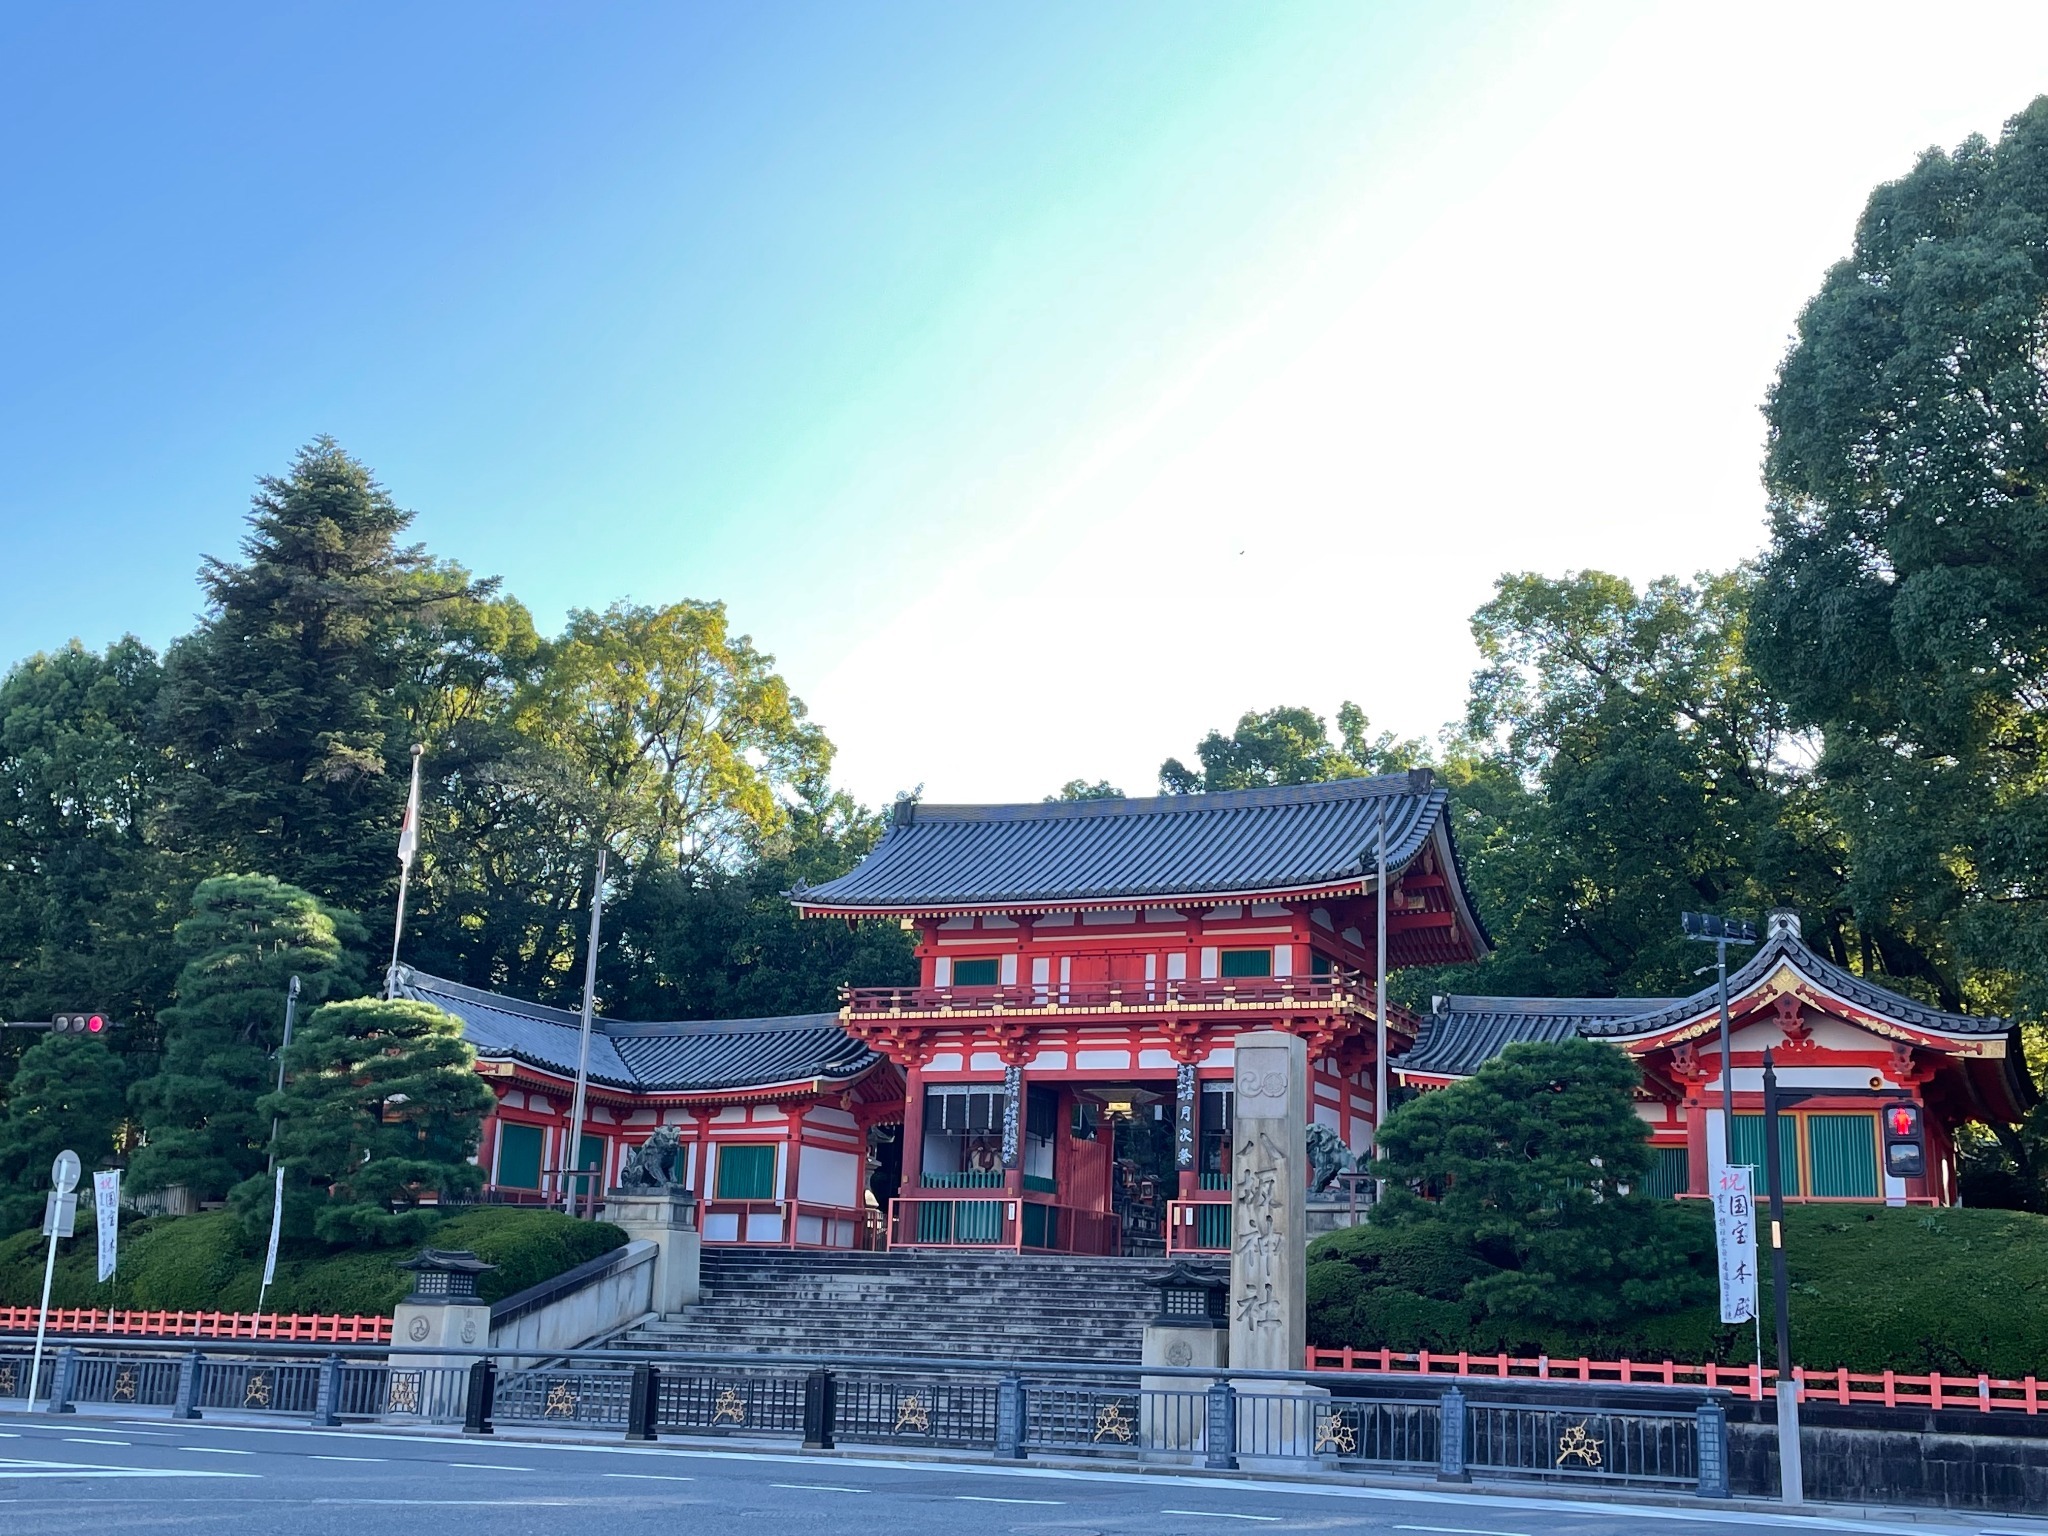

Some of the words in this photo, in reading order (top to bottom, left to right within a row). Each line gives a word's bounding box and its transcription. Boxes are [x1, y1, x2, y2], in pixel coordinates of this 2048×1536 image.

[1177, 1105, 1193, 1165] 月次祭
[1236, 1132, 1286, 1331] 八坂神社
